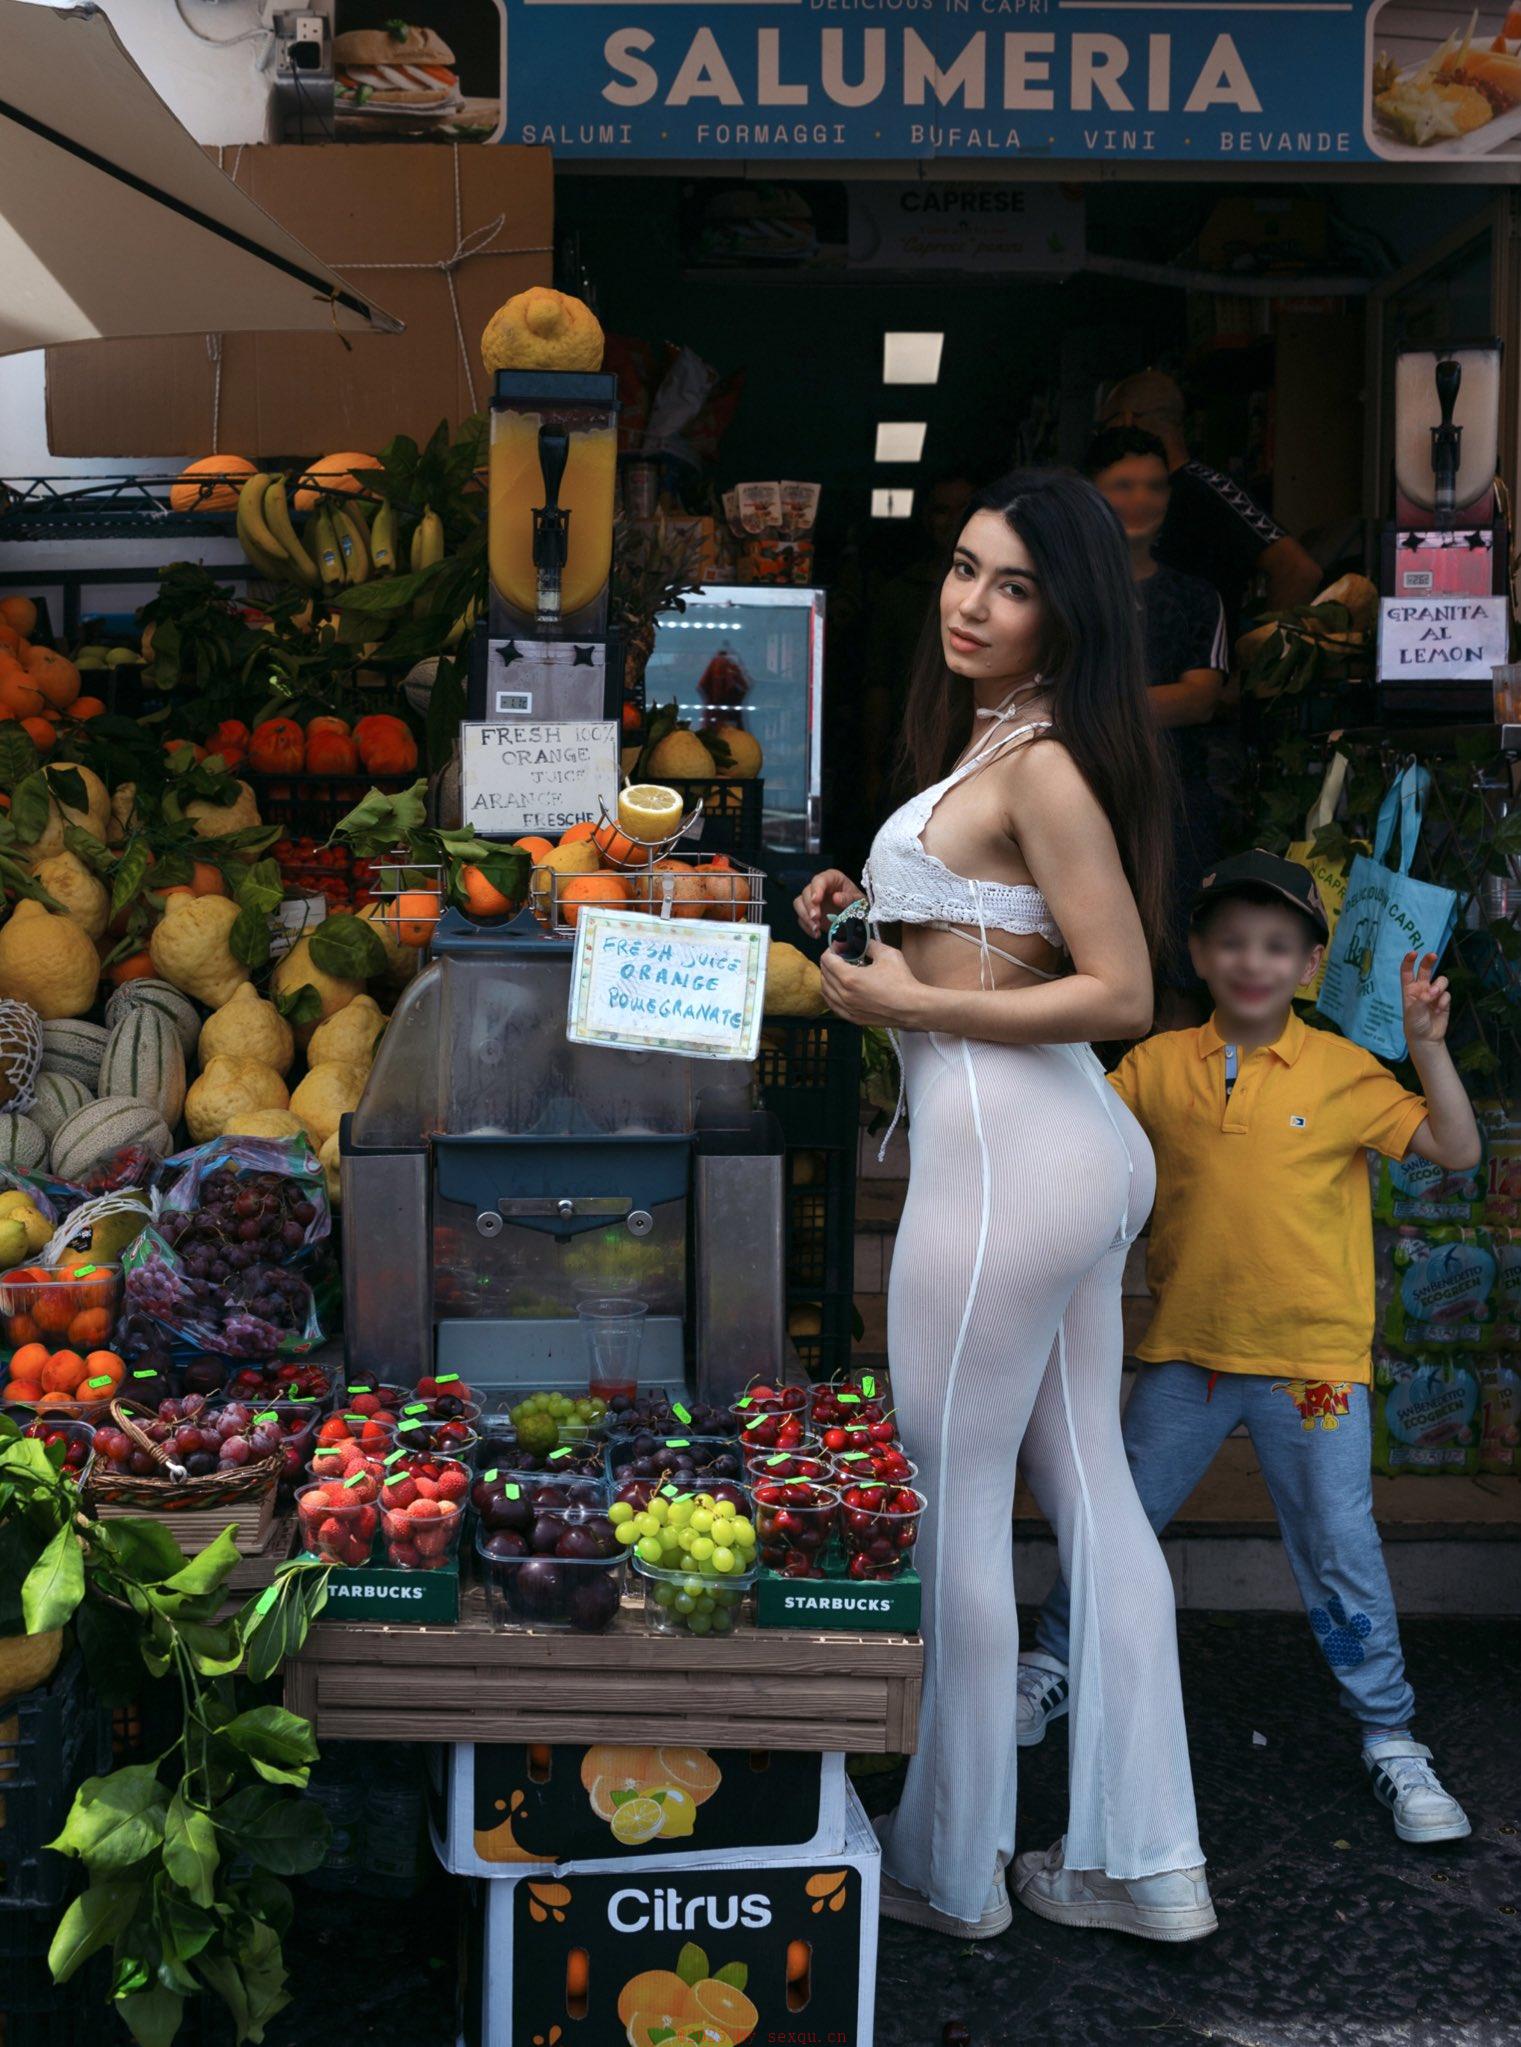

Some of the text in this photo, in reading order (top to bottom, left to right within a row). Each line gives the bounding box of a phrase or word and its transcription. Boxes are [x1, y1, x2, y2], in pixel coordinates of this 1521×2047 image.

[811, 0, 1048, 14] DELICIOUS IN CAPRI
[601, 26, 1263, 112] SALUMERIA
[522, 125, 1350, 152] SALUMI FORMAGGI BUFALA VINI BEVANDE
[900, 191, 1025, 212] CAPRESE
[1387, 605, 1489, 622] GRANITA
[1420, 627, 1452, 641] AL
[1400, 646, 1483, 665] LEMON
[481, 727, 561, 746] FRESH
[502, 748, 591, 766] ORANGE
[1317, 867, 1348, 899] CAPR
[1388, 904, 1424, 950] CAPRI
[602, 935, 673, 962] FRESH
[620, 963, 720, 991] ORANGE
[1408, 1166, 1442, 1184] ECOG
[1430, 1265, 1482, 1292] BENEDETTO
[1420, 1277, 1481, 1306] ECOGREEN
[1403, 1400, 1464, 1430] ECOGREEN
[328, 1585, 423, 1600] TARBUCKS
[784, 1597, 891, 1611] STARBUCKS
[607, 1888, 772, 1933] Citrus
